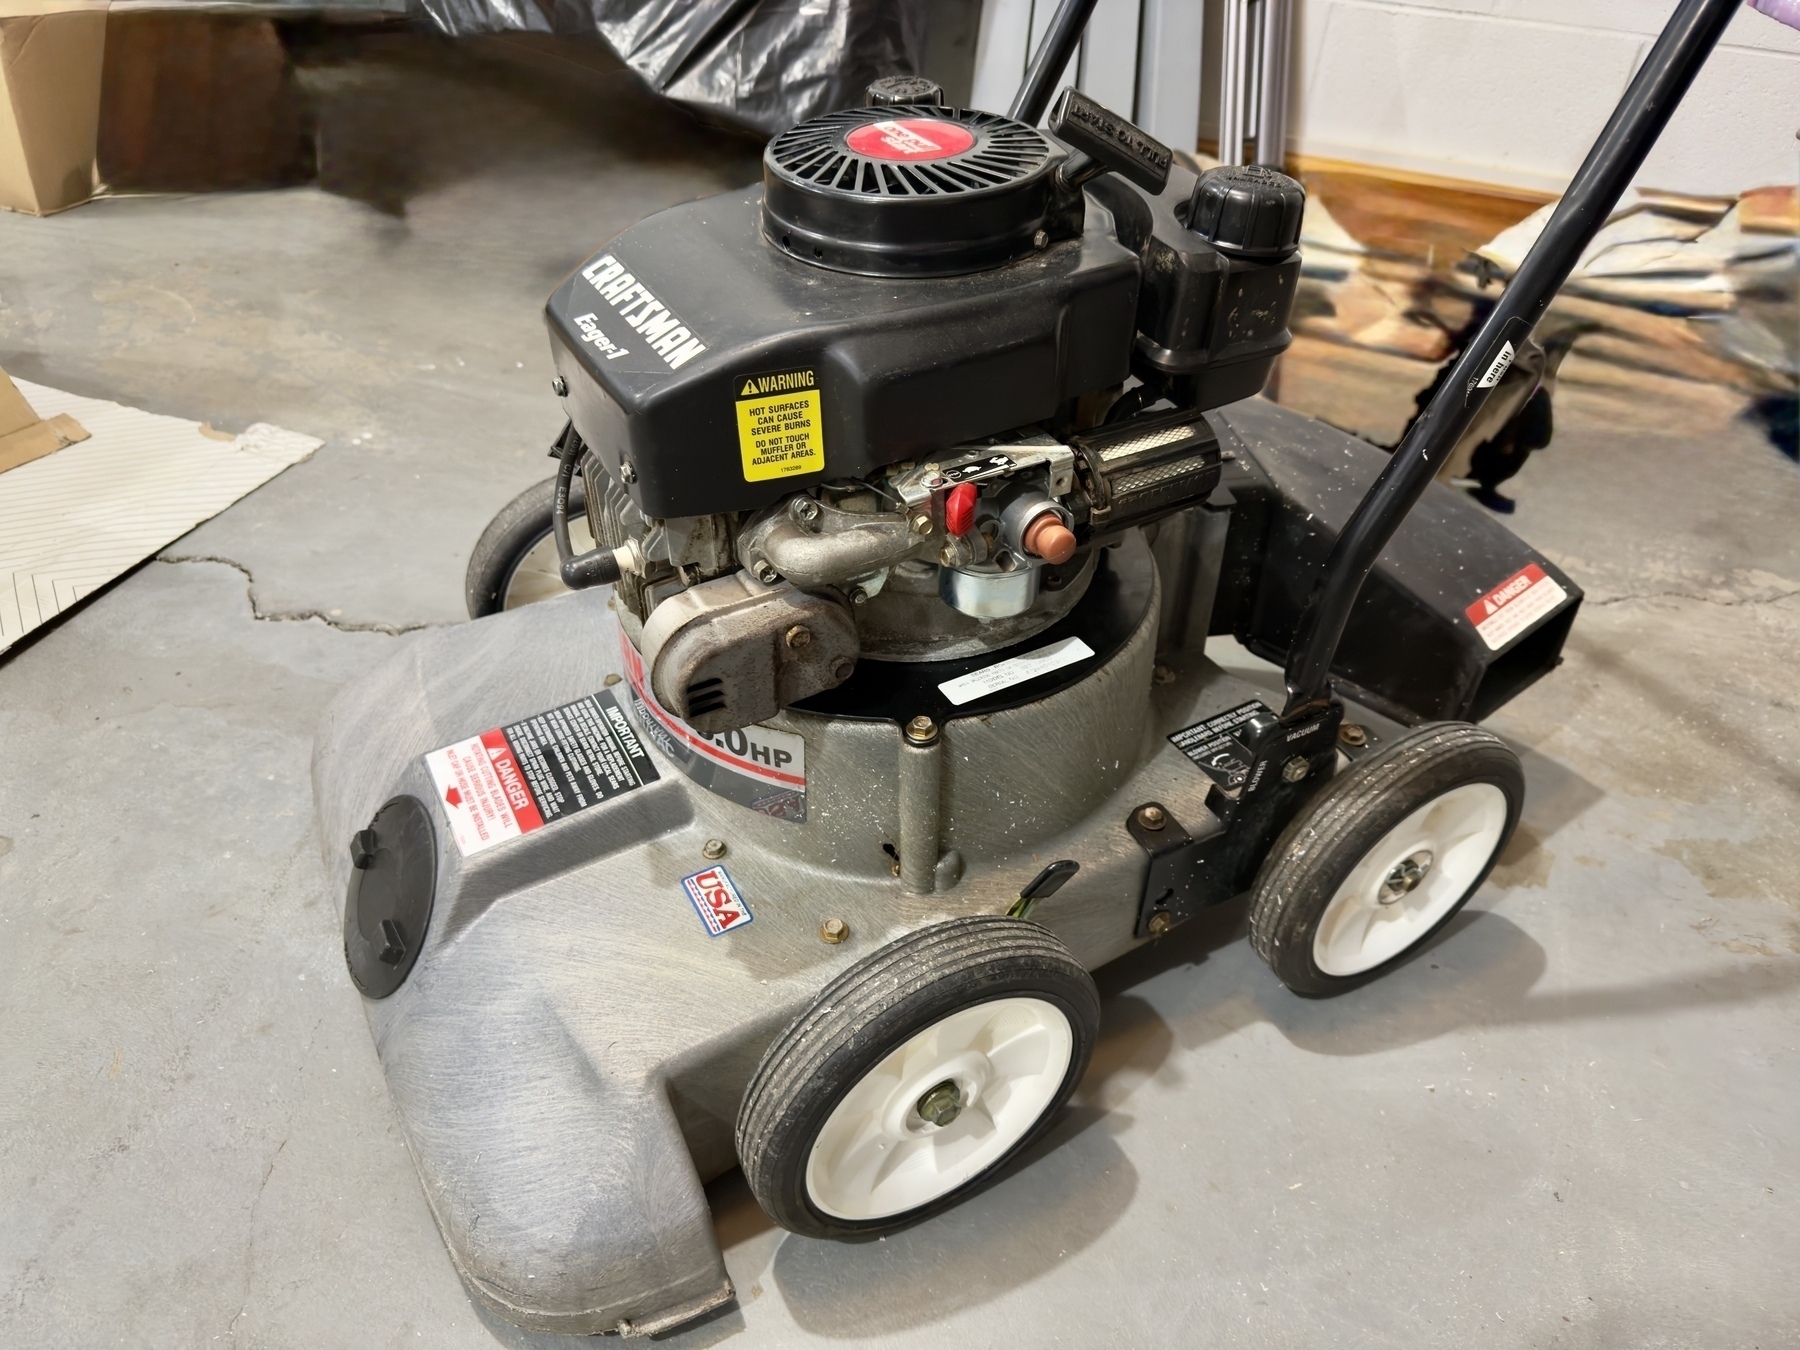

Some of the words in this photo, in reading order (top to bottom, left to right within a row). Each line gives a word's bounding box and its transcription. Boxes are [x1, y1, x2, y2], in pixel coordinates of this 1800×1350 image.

[581, 254, 707, 370] CRAFTSMAN
[574, 312, 630, 360] Eager-1
[1501, 351, 1511, 360] in
[758, 370, 814, 393] WARNING
[1487, 362, 1503, 383] here
[749, 407, 765, 416] HOT
[769, 400, 810, 413] SURFACES
[758, 415, 774, 425] CAN
[777, 411, 803, 422] CAUSE
[751, 424, 782, 436] SEVERE
[784, 420, 811, 432] BURNS
[756, 439, 766, 447] DO
[768, 436, 784, 446] NOT
[786, 433, 810, 443] TOUCH
[760, 444, 794, 456] MUFFLER
[796, 442, 806, 450] OR
[752, 453, 789, 466] ADJACENT
[791, 449, 816, 461] AREAS.
[1493, 576, 1531, 605] DANGER
[1172, 725, 1206, 742] IMPORTANT:
[1207, 712, 1237, 728] CORRECTLY
[1236, 702, 1262, 715] POSITION
[1212, 721, 1234, 733] BEFORE
[606, 706, 644, 758] IMPORTANT
[1286, 723, 1320, 742] VACUUM
[447, 749, 457, 759] INLET
[552, 745, 565, 763] CHILDREN
[579, 737, 590, 750] SEARS
[586, 749, 596, 763] RETAIL
[1187, 745, 1209, 757] BLOWER
[1208, 736, 1231, 748] POSITION
[451, 761, 461, 769] CAP
[529, 758, 540, 770] SPARK
[561, 763, 570, 772] AND
[567, 736, 578, 749] SAFETY
[574, 749, 587, 766] GLASSES
[583, 766, 592, 775] AND
[596, 791, 604, 799] DO
[587, 736, 600, 752] CONTACT
[596, 752, 606, 763] YOUR
[601, 762, 612, 776] LOCAL
[608, 775, 620, 790] SEARS
[600, 742, 608, 751] FOR
[606, 754, 625, 781] REPLACEMENT
[613, 751, 625, 767] BEFORE
[621, 766, 636, 786] STARTING
[519, 753, 529, 765] PARTS
[526, 770, 536, 780] STOP
[531, 780, 543, 796] BEFORE
[535, 770, 545, 781] PLUG
[537, 755, 550, 773] BECOMES
[554, 792, 565, 803] STOP
[566, 771, 575, 782] PETS
[1248, 760, 1267, 792] BLOWER
[459, 778, 469, 790] HOSE
[463, 756, 476, 773] CAUSE
[470, 774, 486, 797] SERIOUS
[481, 797, 495, 819] INJURY!
[472, 743, 486, 766] ROTATING
[481, 766, 496, 789] CUTTING
[490, 789, 506, 812] BLADES
[500, 812, 512, 828] WILL
[496, 759, 529, 809] DANGER
[570, 782, 581, 794] AWAY
[464, 790, 475, 803] MUST
[546, 792, 555, 802] AND
[576, 794, 587, 807] FROM
[550, 801, 560, 813] WAIT
[696, 871, 740, 929] USA
